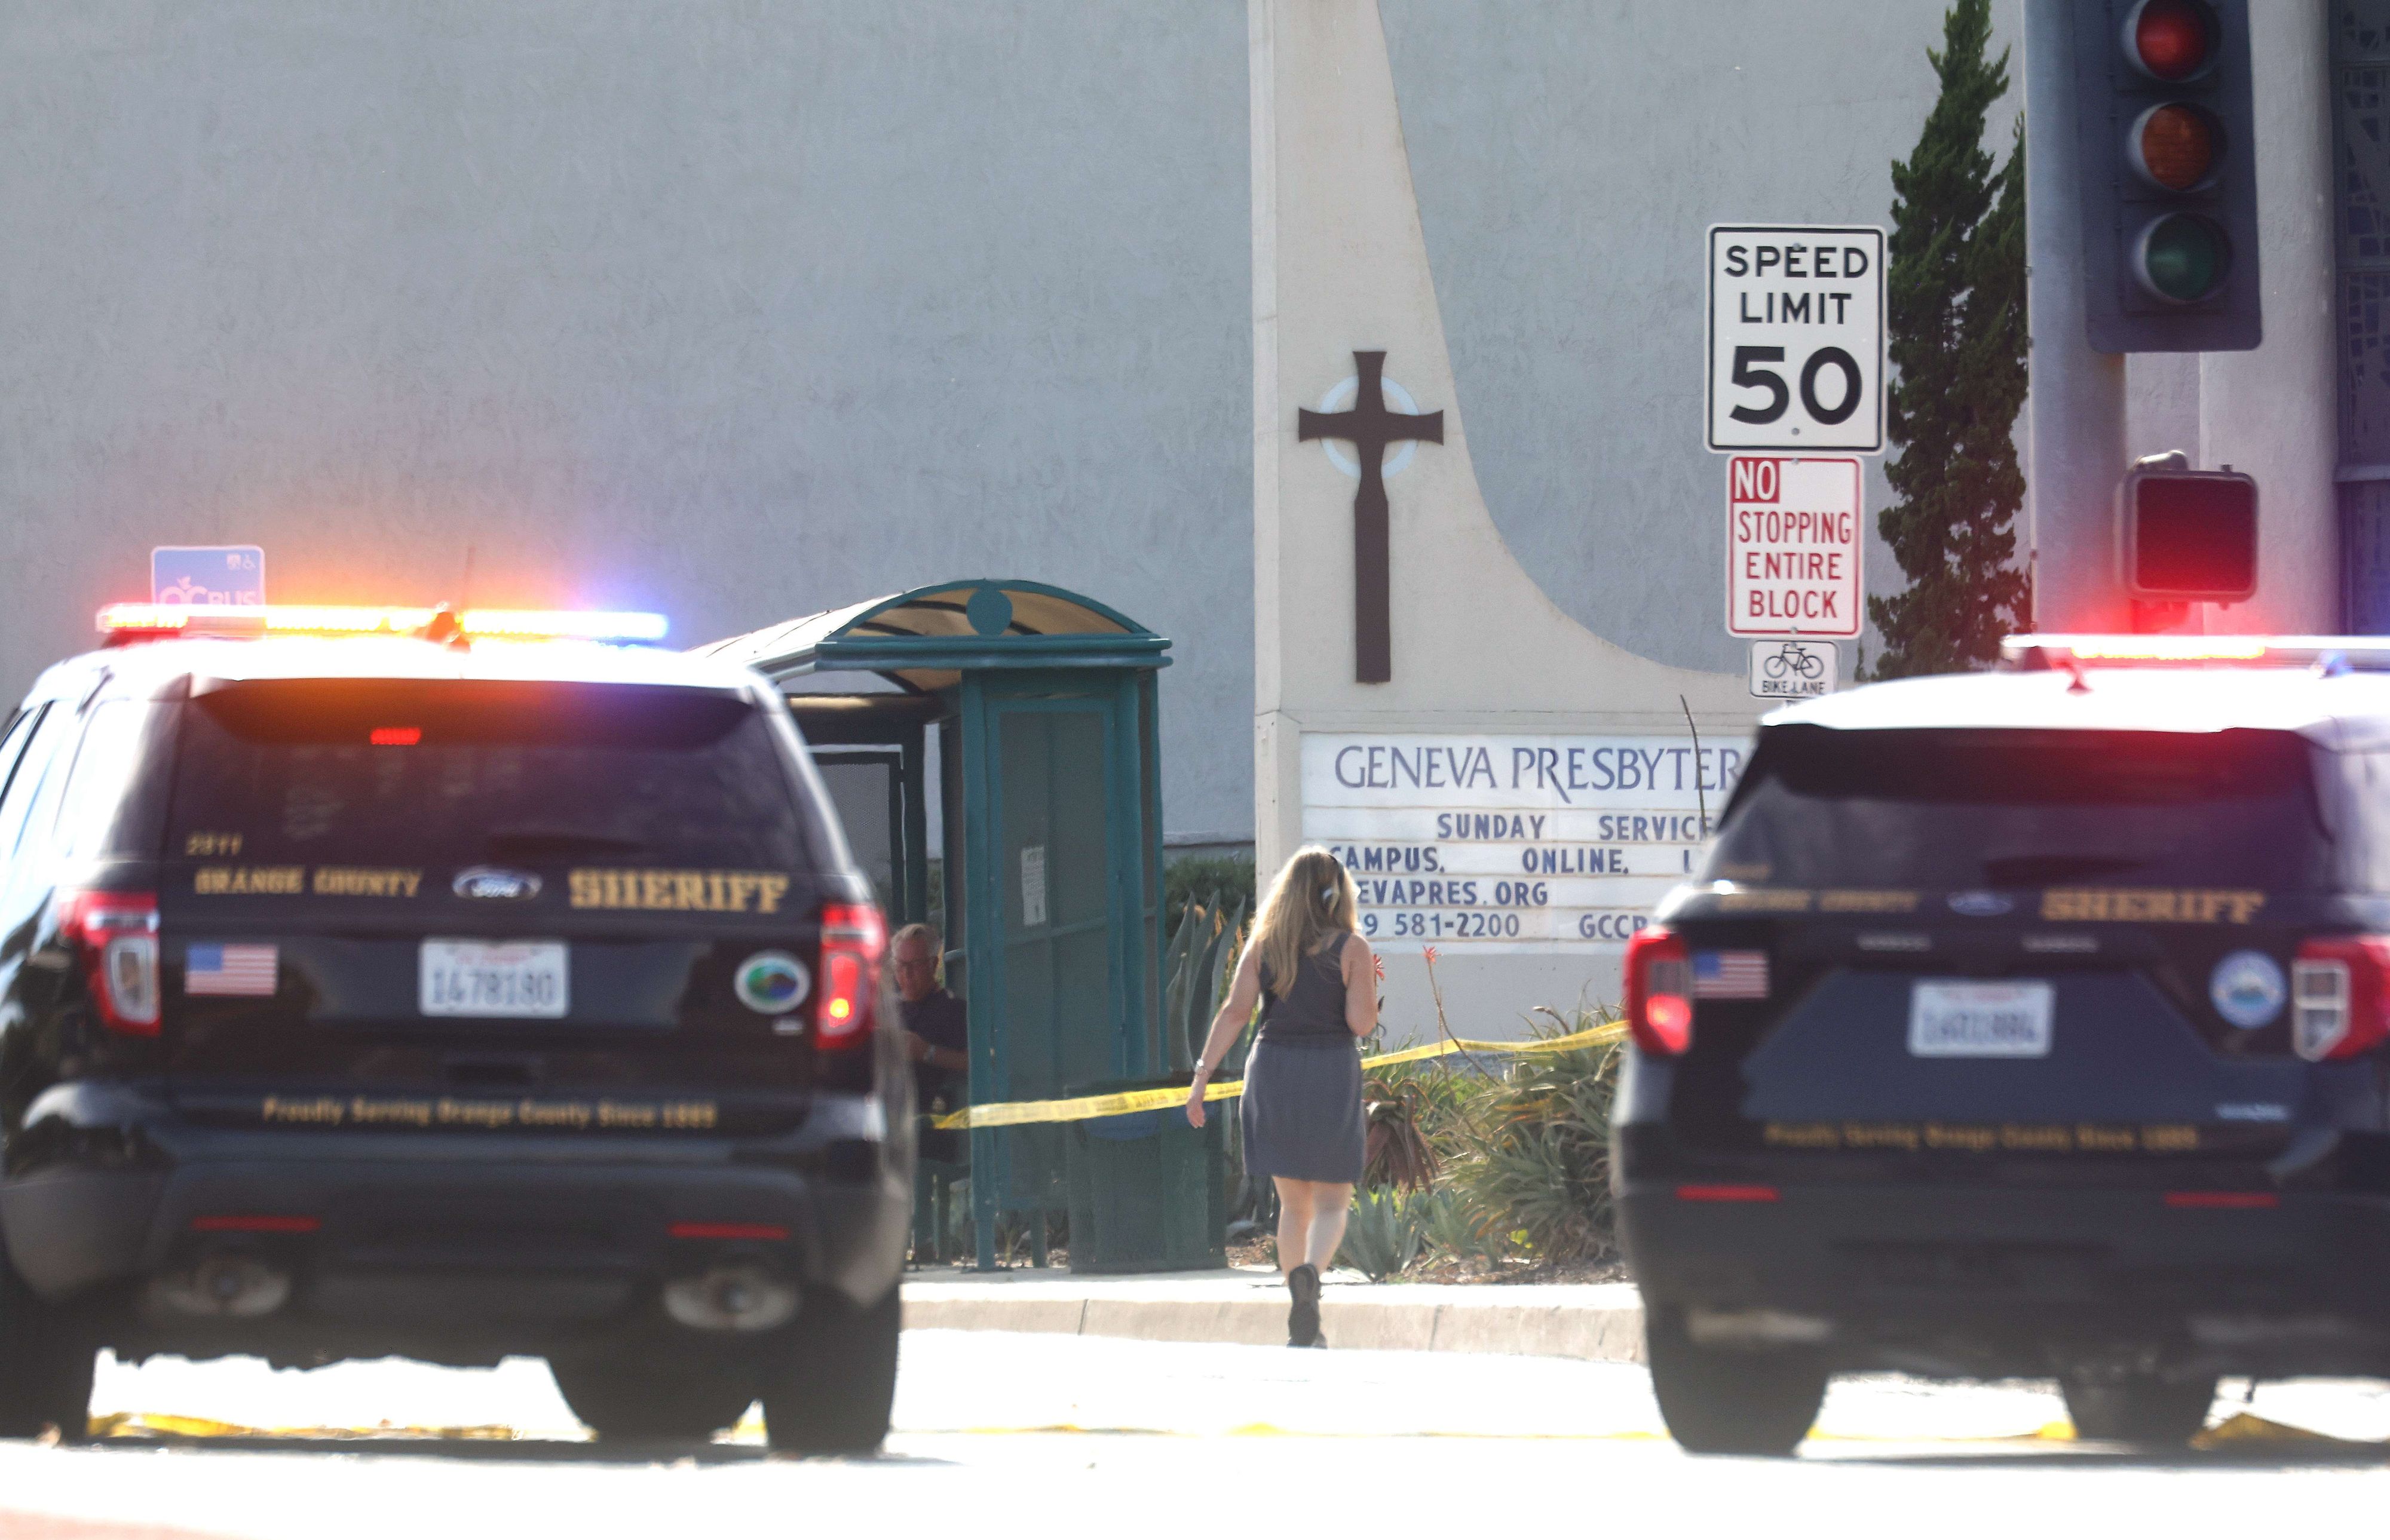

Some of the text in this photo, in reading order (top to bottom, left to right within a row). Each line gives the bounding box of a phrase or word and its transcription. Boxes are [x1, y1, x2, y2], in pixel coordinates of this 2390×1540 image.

[1724, 245, 1868, 278] SPEED
[1740, 292, 1852, 324] LIMIT
[1729, 345, 1862, 425] 50
[1735, 461, 1776, 501] NO
[1738, 510, 1852, 545] STOPPING
[1746, 552, 1843, 581] ENTIRE
[1749, 590, 1838, 619] BLOCK
[1763, 680, 1825, 695] BIKE LANE
[1334, 746, 1497, 789] GENEVA
[1438, 813, 1546, 839] SUNDAY
[194, 864, 423, 897] ORANGE COUNTY
[568, 867, 789, 913] SHERIFF
[2041, 887, 2264, 924] SHERIFF
[1394, 913, 1519, 938] 581-2200
[263, 1094, 345, 1128] Proudly
